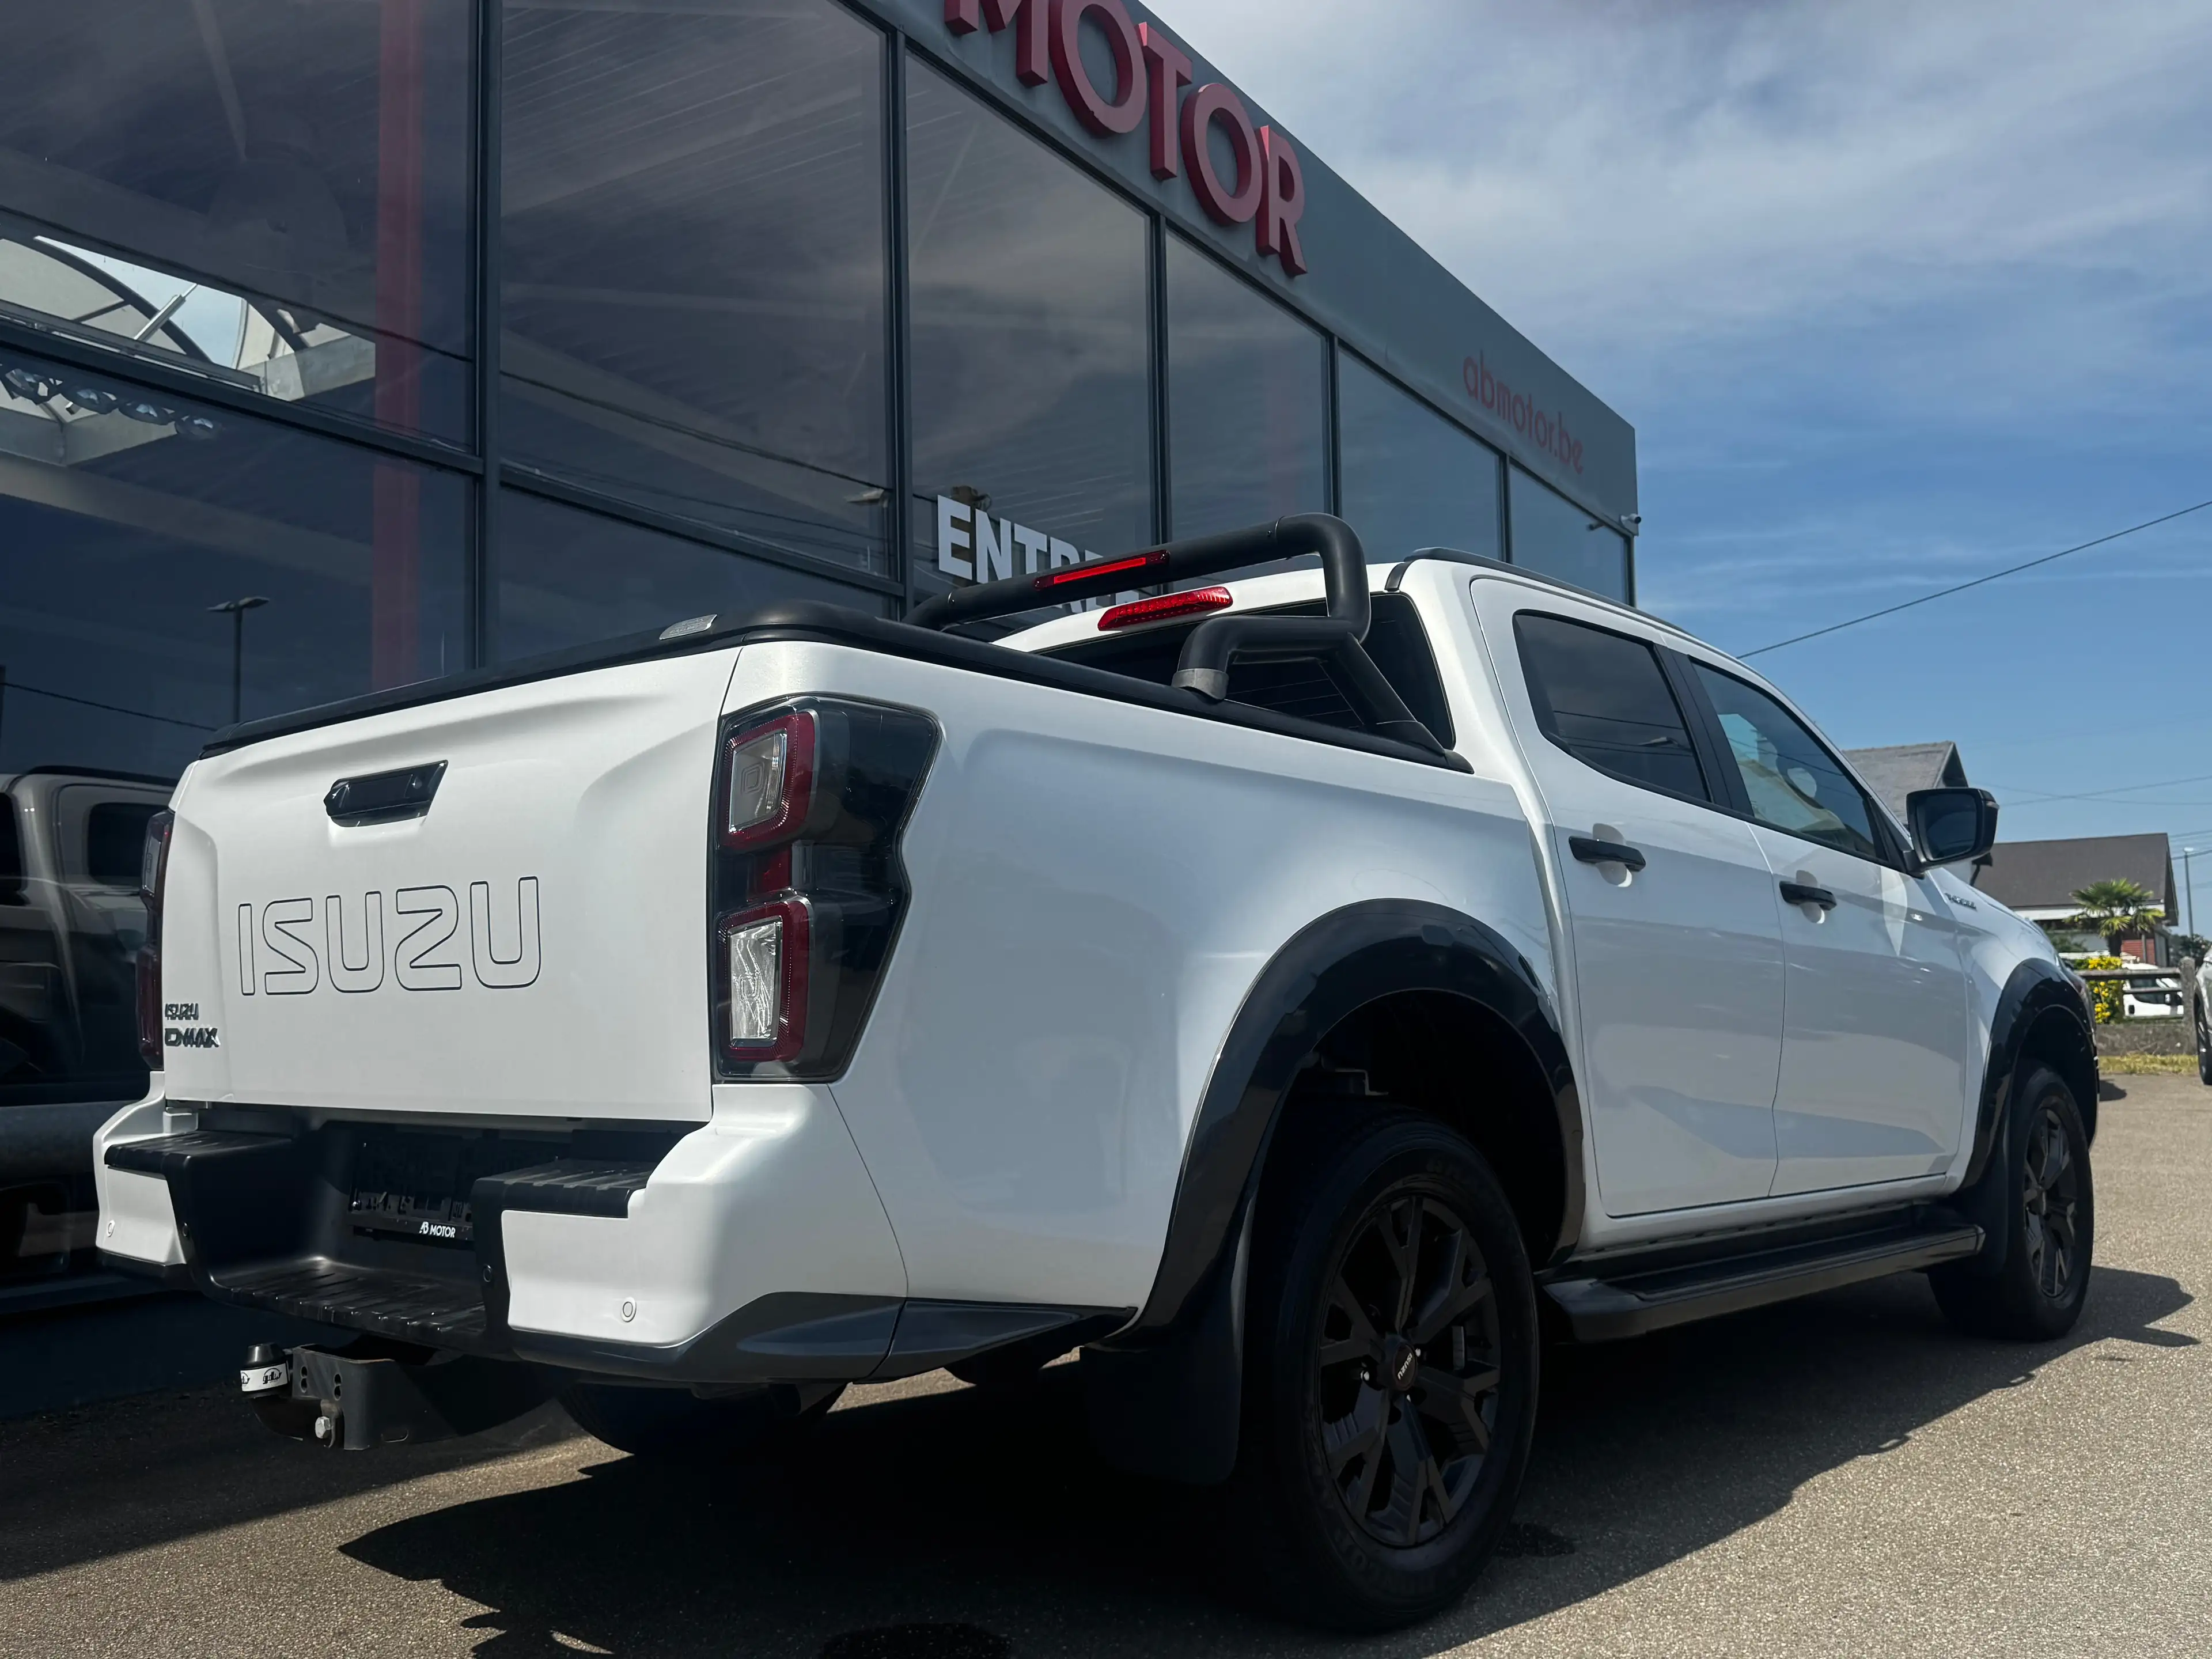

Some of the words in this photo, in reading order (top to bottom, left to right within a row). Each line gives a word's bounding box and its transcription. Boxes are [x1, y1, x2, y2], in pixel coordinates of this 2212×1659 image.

[1463, 349, 1584, 475] abmotor.be
[238, 876, 541, 996] ISUZU
[165, 1003, 199, 1020] ISUZU
[429, 1224, 456, 1238] MOTOR
